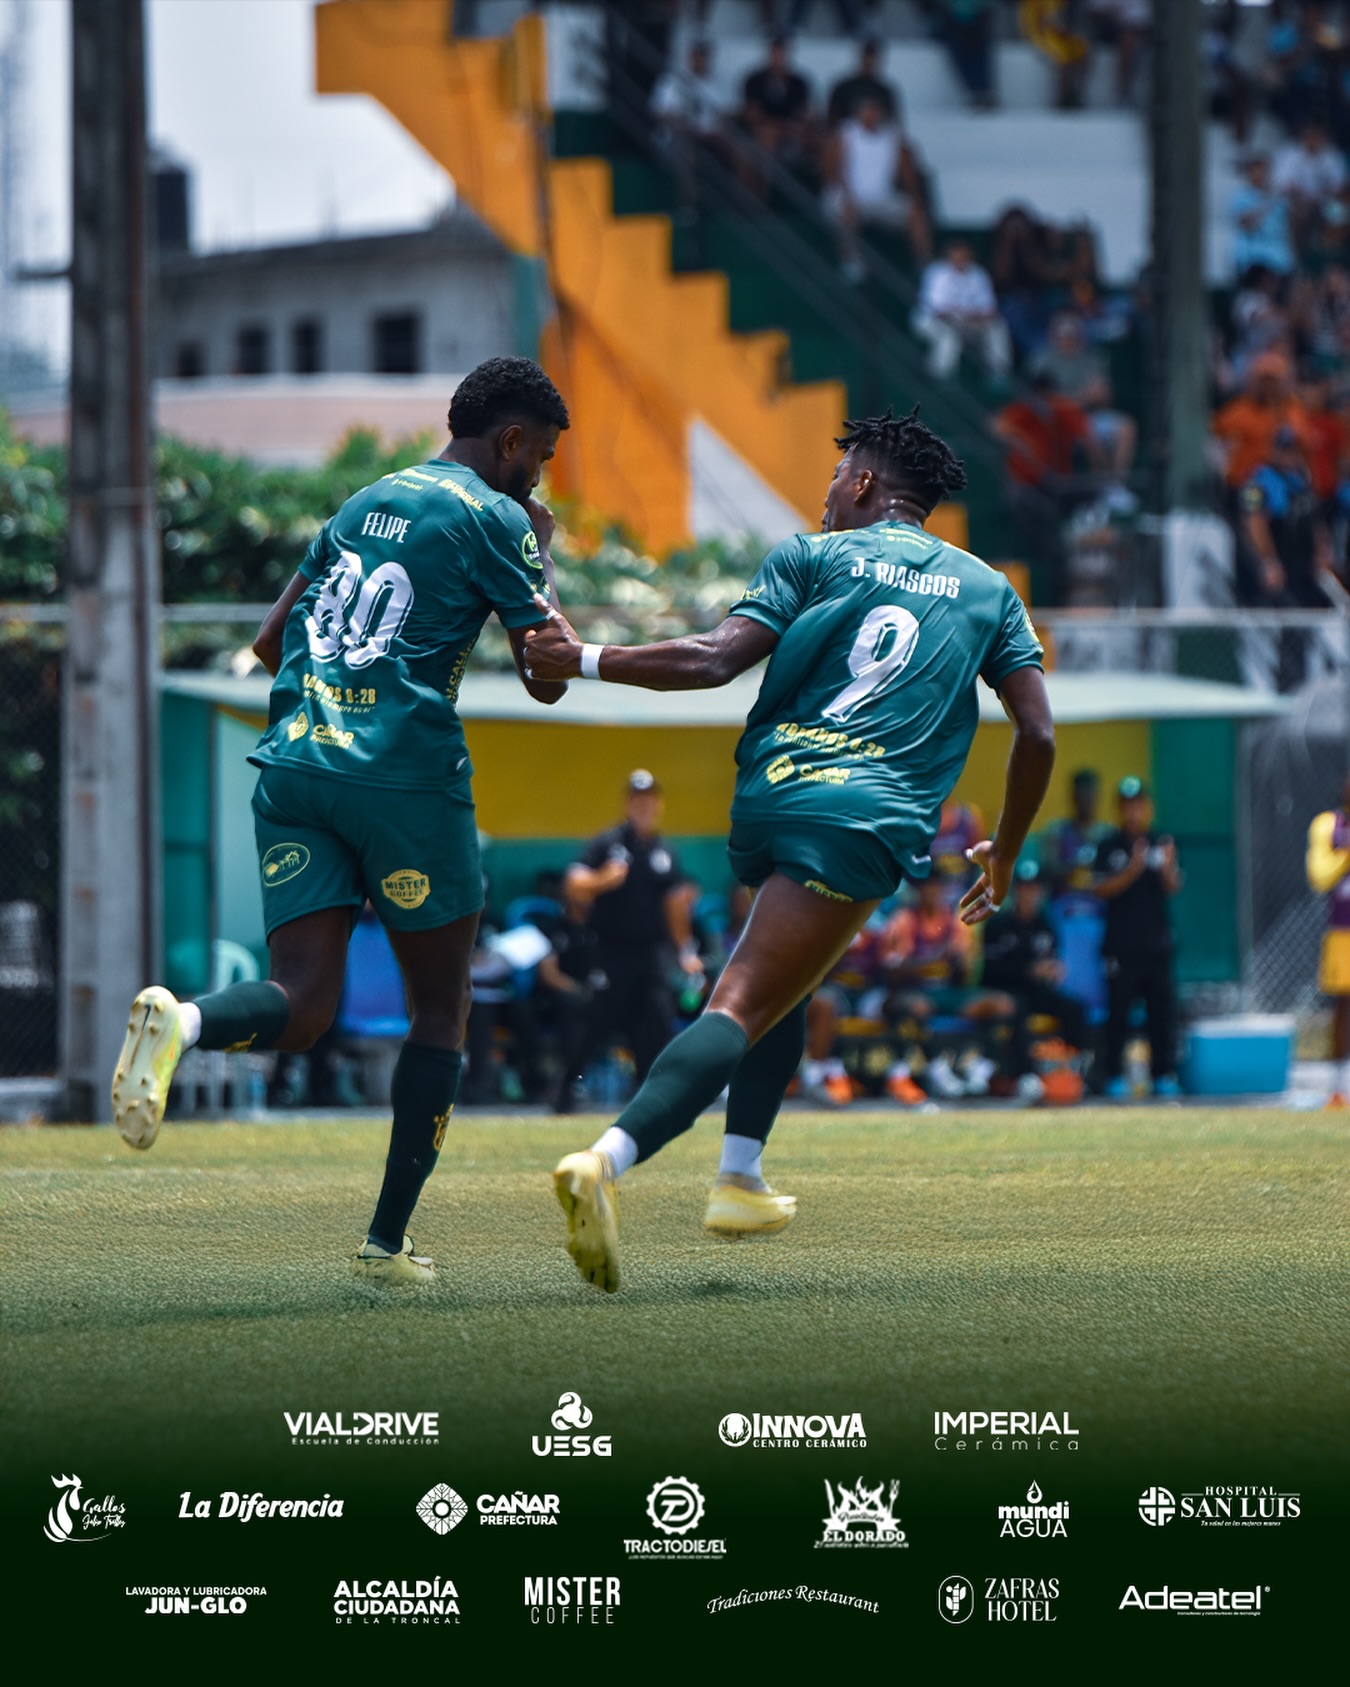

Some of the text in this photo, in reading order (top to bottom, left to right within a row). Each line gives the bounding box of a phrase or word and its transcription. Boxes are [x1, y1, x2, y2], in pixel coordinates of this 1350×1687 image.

[361, 511, 412, 543] FELIPE
[851, 557, 960, 599] J. RIASCOS
[305, 550, 414, 670] 80
[821, 605, 920, 723] 9
[345, 688, 376, 704] 8:28
[385, 878, 426, 890] MISTER
